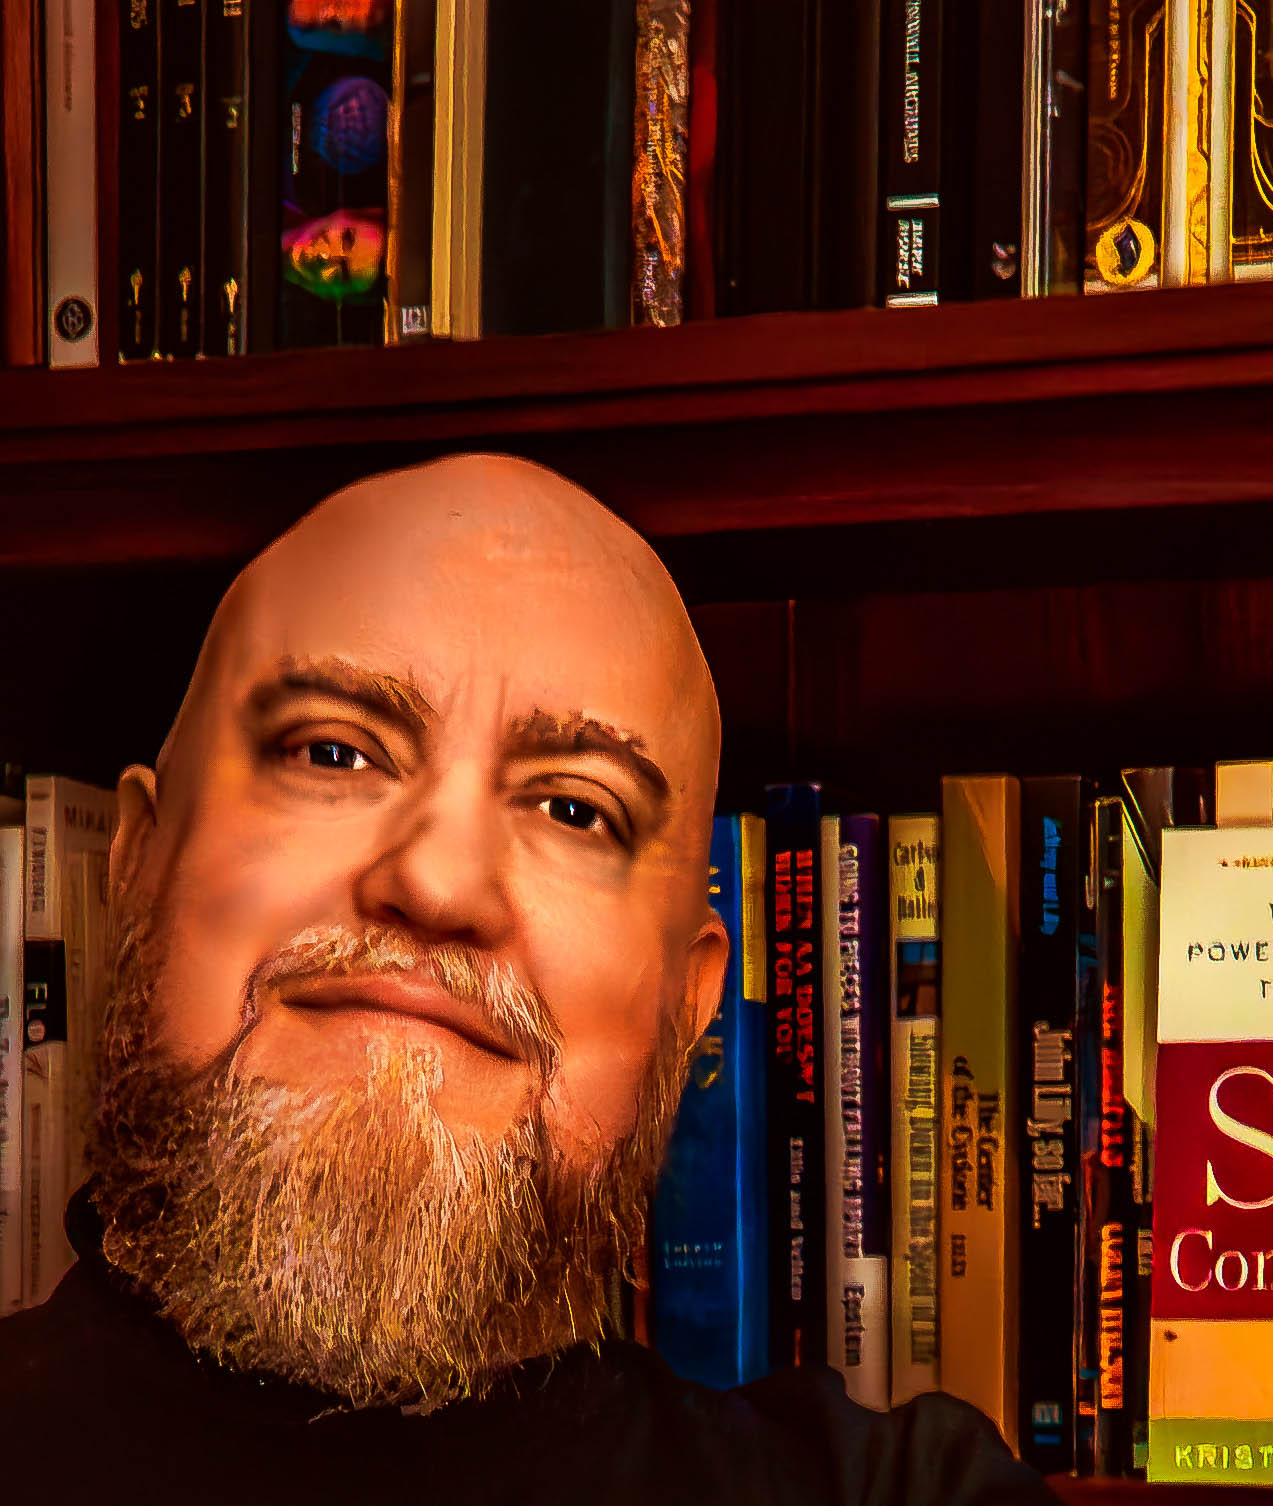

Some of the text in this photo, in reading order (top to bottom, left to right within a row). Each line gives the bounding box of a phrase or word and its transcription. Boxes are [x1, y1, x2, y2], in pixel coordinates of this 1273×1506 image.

[774, 851, 795, 1064] WORK FOR YOU
[793, 849, 816, 1105] WHEN AA DOESN'T
[1031, 1020, 1074, 1082] John
[946, 1056, 975, 1212] of the Cyclone
[976, 1092, 1000, 1213] The Center
[1033, 1140, 1068, 1171] so
[1032, 1172, 1074, 1231] far...
[840, 1285, 867, 1368] Epstein
